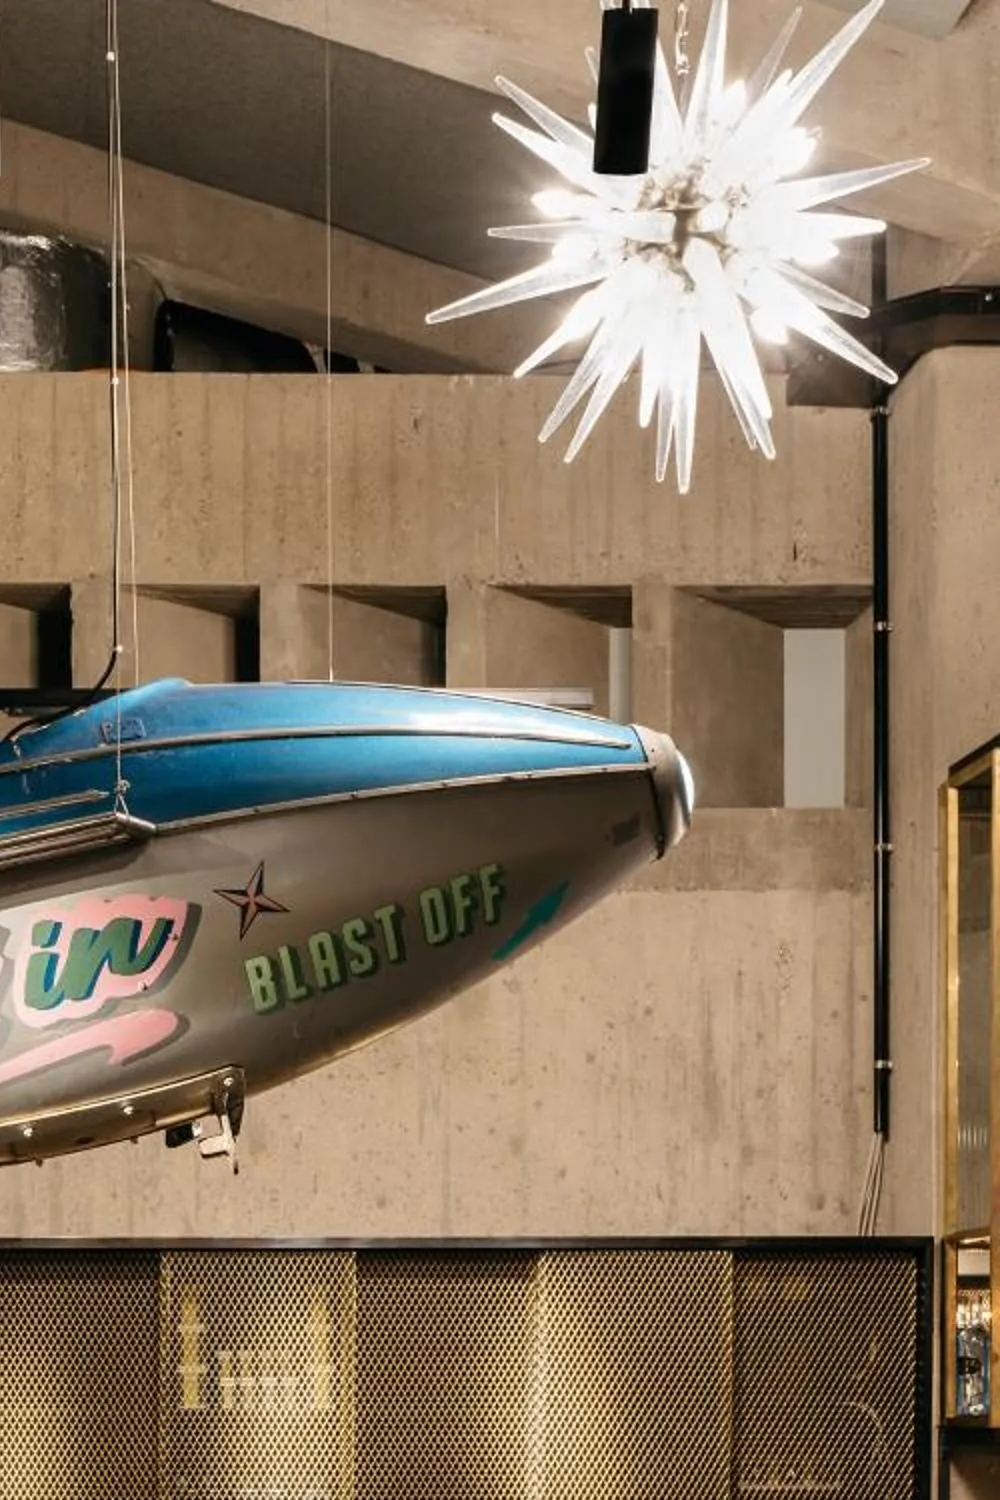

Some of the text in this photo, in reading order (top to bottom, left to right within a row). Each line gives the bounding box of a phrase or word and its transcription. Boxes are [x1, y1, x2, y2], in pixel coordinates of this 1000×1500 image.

[23, 916, 175, 1009] in
[245, 863, 507, 1013] BLAST OFF
